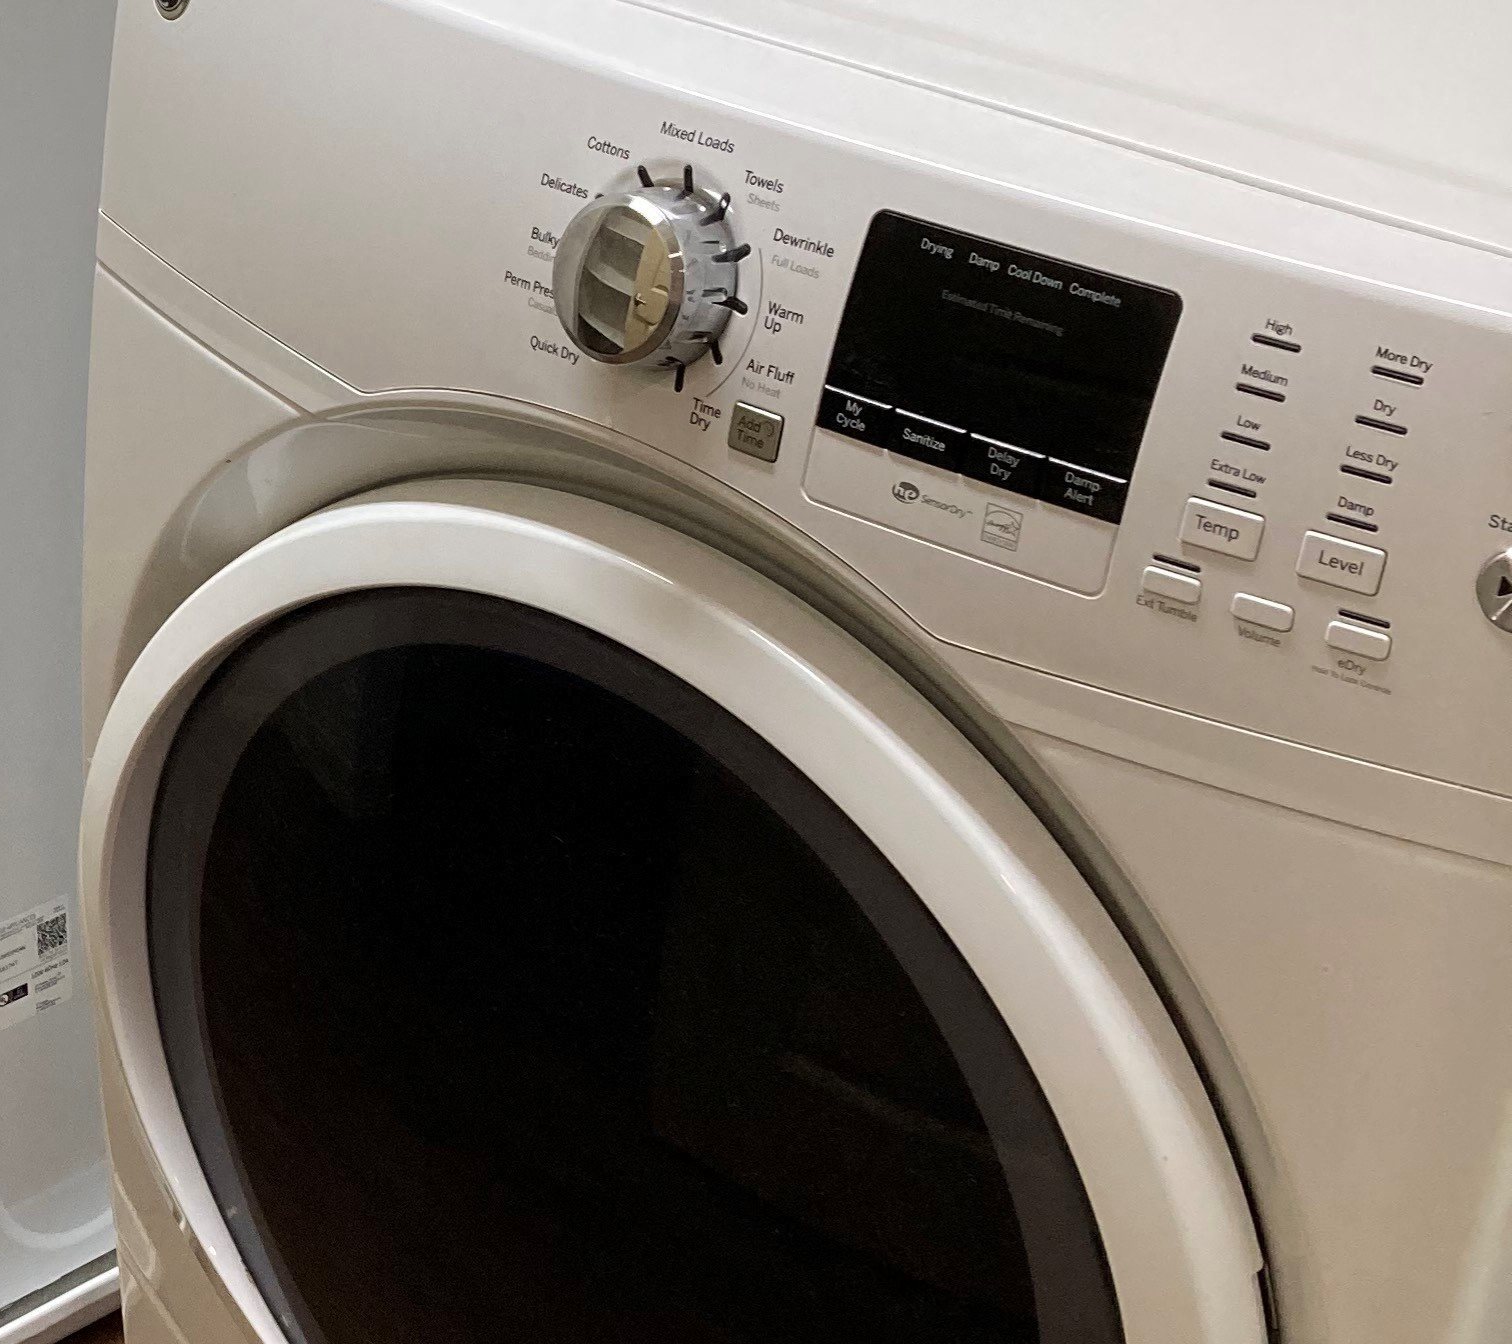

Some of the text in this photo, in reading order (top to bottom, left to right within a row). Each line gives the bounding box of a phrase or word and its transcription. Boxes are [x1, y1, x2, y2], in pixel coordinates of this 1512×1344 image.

[587, 136, 630, 160] Cottons
[660, 121, 735, 154] Mixed Loads
[540, 173, 588, 199] Delicates
[744, 169, 785, 194] Towels
[747, 192, 781, 213] Sheets
[531, 226, 561, 249] Bulky
[773, 227, 835, 258] Dewrinkle
[920, 237, 954, 259] Drying
[771, 254, 820, 279] Full Loads
[968, 252, 1000, 272] Damp
[504, 270, 555, 300] Perm Pres
[1007, 264, 1064, 290] Cool Down
[1069, 282, 1121, 308] Complete
[768, 300, 804, 324] Warm
[764, 316, 782, 334] Up
[1265, 318, 1293, 336] High
[530, 335, 580, 366] Quick Dry
[1375, 346, 1434, 374] More Dry
[746, 358, 795, 385] Air Fluff
[1241, 363, 1288, 387] Medium
[741, 377, 782, 399] No Heat
[693, 397, 722, 419] Time
[845, 399, 863, 416] My
[1373, 398, 1397, 416] Dry
[689, 411, 711, 432] Dry
[738, 415, 762, 434] Add
[835, 412, 866, 432] Cycle
[1237, 414, 1262, 432] Low
[737, 429, 765, 449] Time
[902, 427, 947, 453] Sanitize
[988, 446, 1021, 469] Delay
[1345, 445, 1399, 472] Less Dry
[990, 462, 1013, 481] Dry
[1065, 470, 1101, 493] Damp
[1210, 458, 1267, 485] Extra Low
[1064, 487, 1095, 506] Alert
[1337, 495, 1375, 517] Damp
[1195, 513, 1240, 543] Temp
[1318, 549, 1365, 576] Level
[1136, 594, 1198, 623] Ext Tumble
[1237, 623, 1281, 647] Volume
[1337, 658, 1366, 675] eDry
